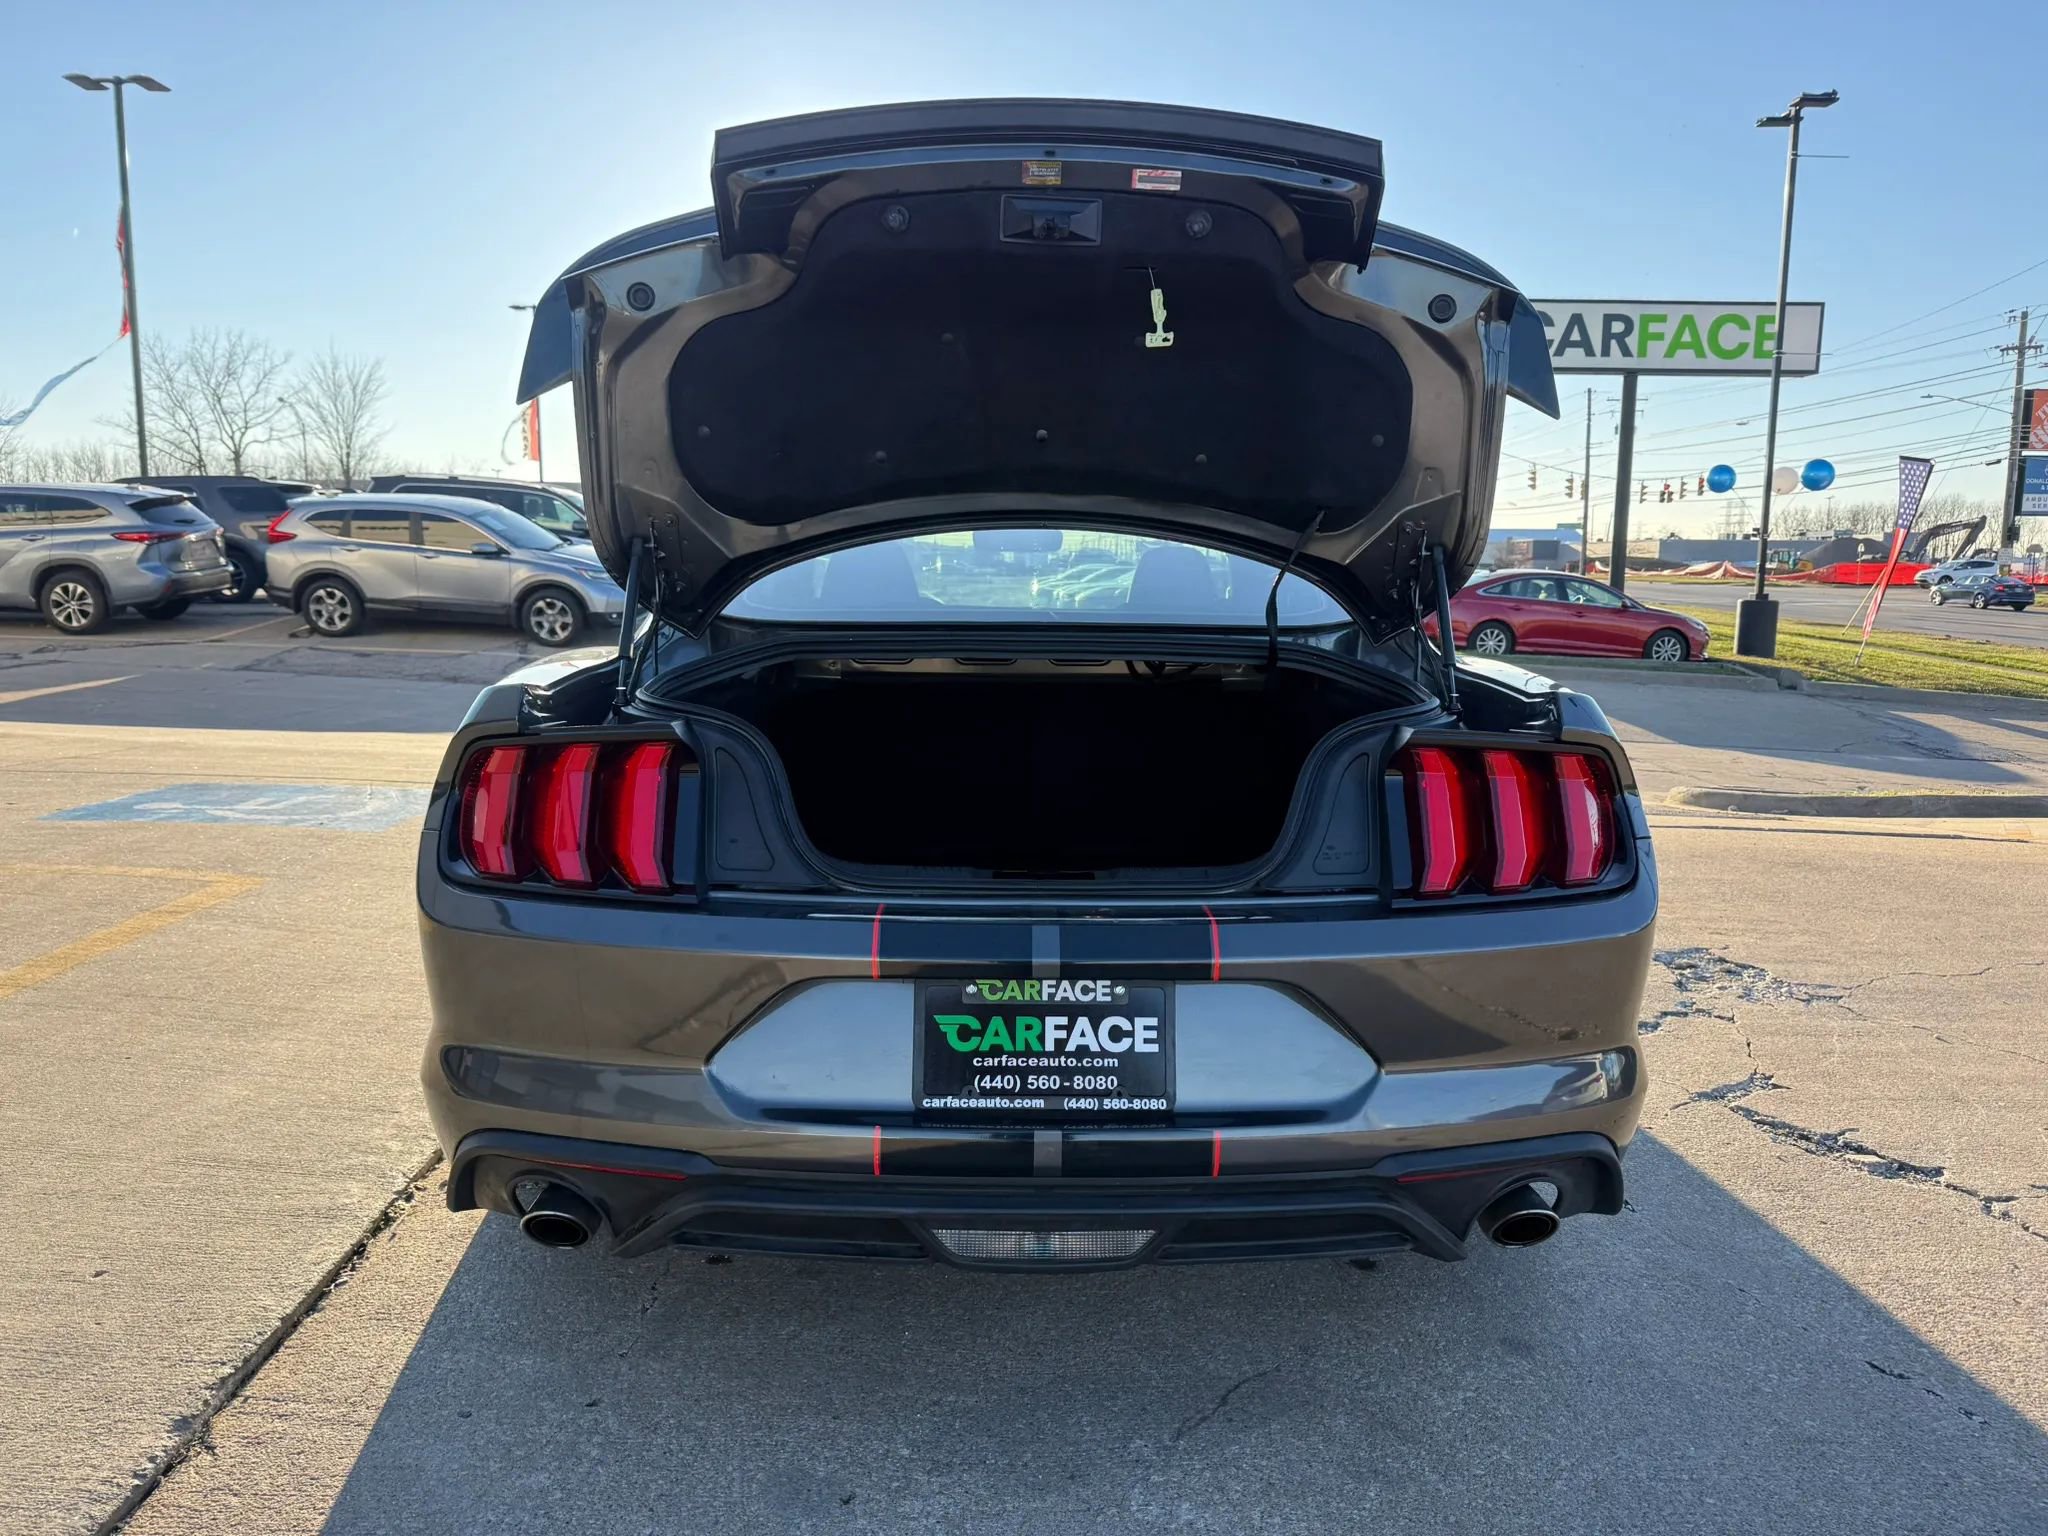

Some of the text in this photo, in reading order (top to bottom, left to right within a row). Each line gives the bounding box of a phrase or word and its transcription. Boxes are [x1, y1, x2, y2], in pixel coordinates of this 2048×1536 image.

[976, 980, 1112, 1002] CARFACE
[933, 1015, 1159, 1052] CARFACE
[973, 1055, 1118, 1067] carfaceauto.com
[974, 1075, 1021, 1093] (440)
[922, 1096, 1167, 1111] carfaceauto.com (440) 560-8080
